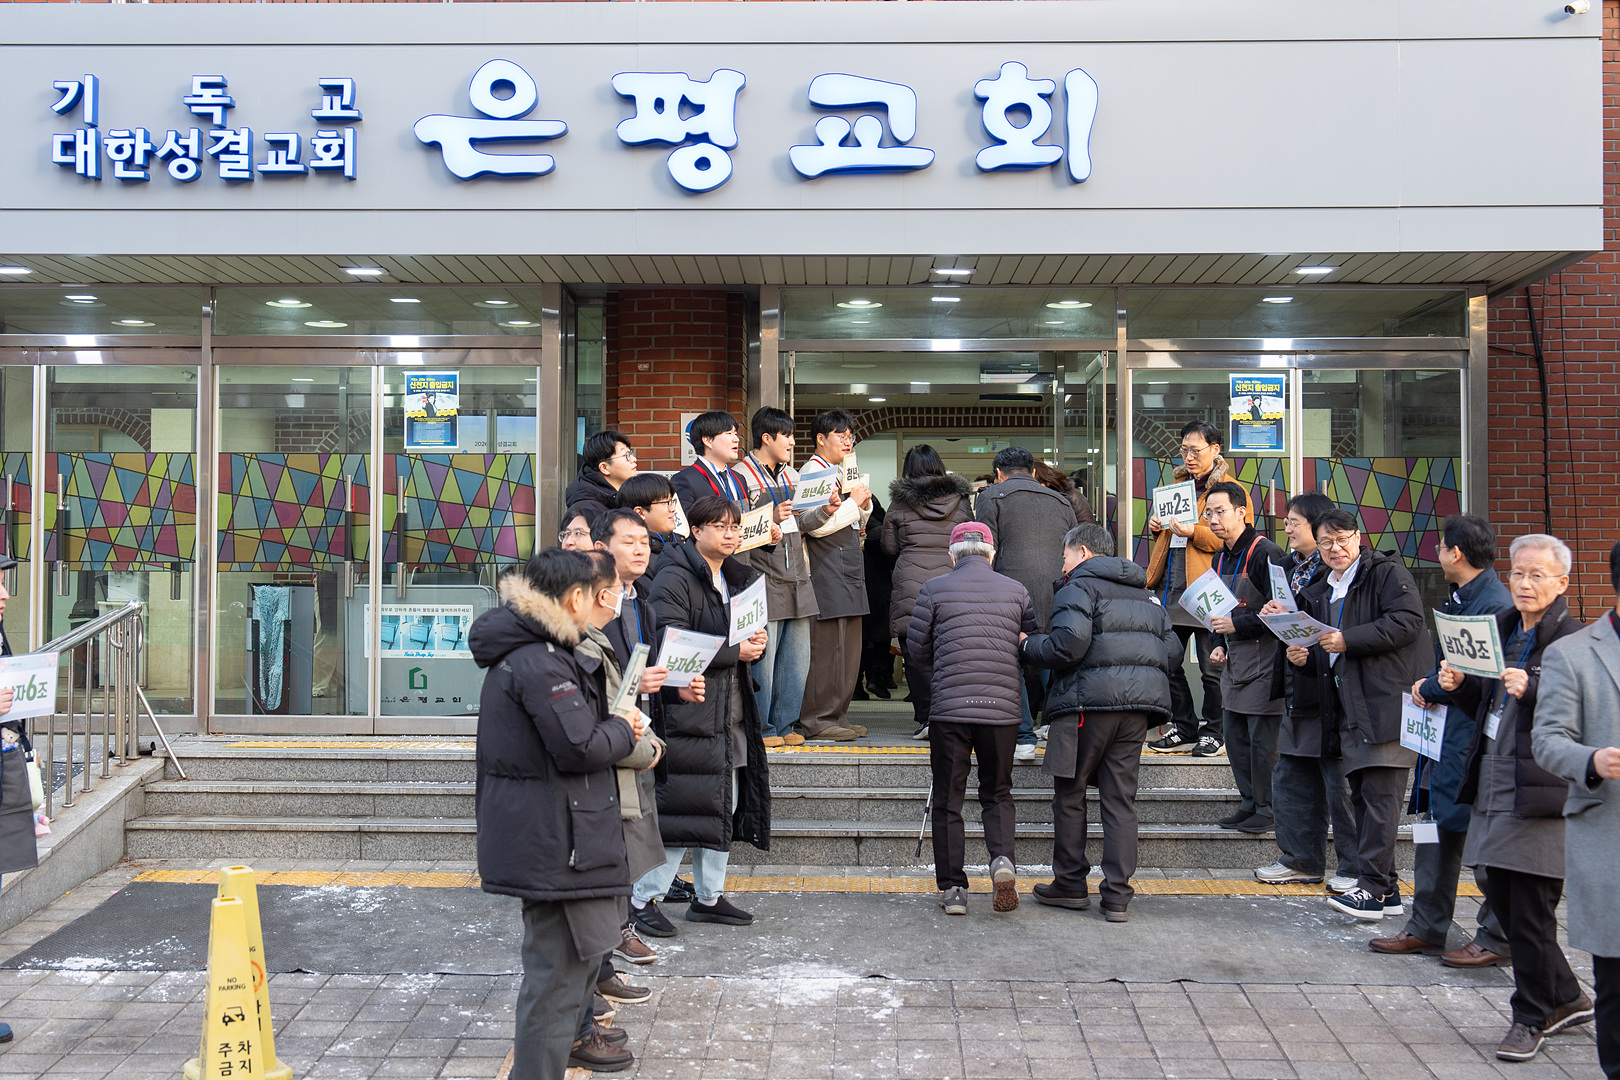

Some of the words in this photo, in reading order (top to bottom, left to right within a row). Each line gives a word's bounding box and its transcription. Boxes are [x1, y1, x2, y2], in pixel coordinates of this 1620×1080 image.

[413, 58, 1100, 193] 은평교회
[51, 126, 358, 181] 대한성결교회
[801, 480, 832, 499] 청년4조
[1158, 492, 1191, 518] 남자2조
[743, 515, 769, 540] 청년4조
[736, 598, 765, 631] 남자7조
[1194, 589, 1226, 622] 남자7조
[1277, 623, 1322, 641] 남자5조
[1442, 628, 1491, 660] 남자3조
[666, 651, 706, 674] 남자6조
[5, 674, 48, 702] 자6조
[1406, 717, 1438, 744] 남자5조
[218, 983, 246, 992] PARKING
[218, 1039, 252, 1058] 주차
[218, 1058, 252, 1077] 금지
